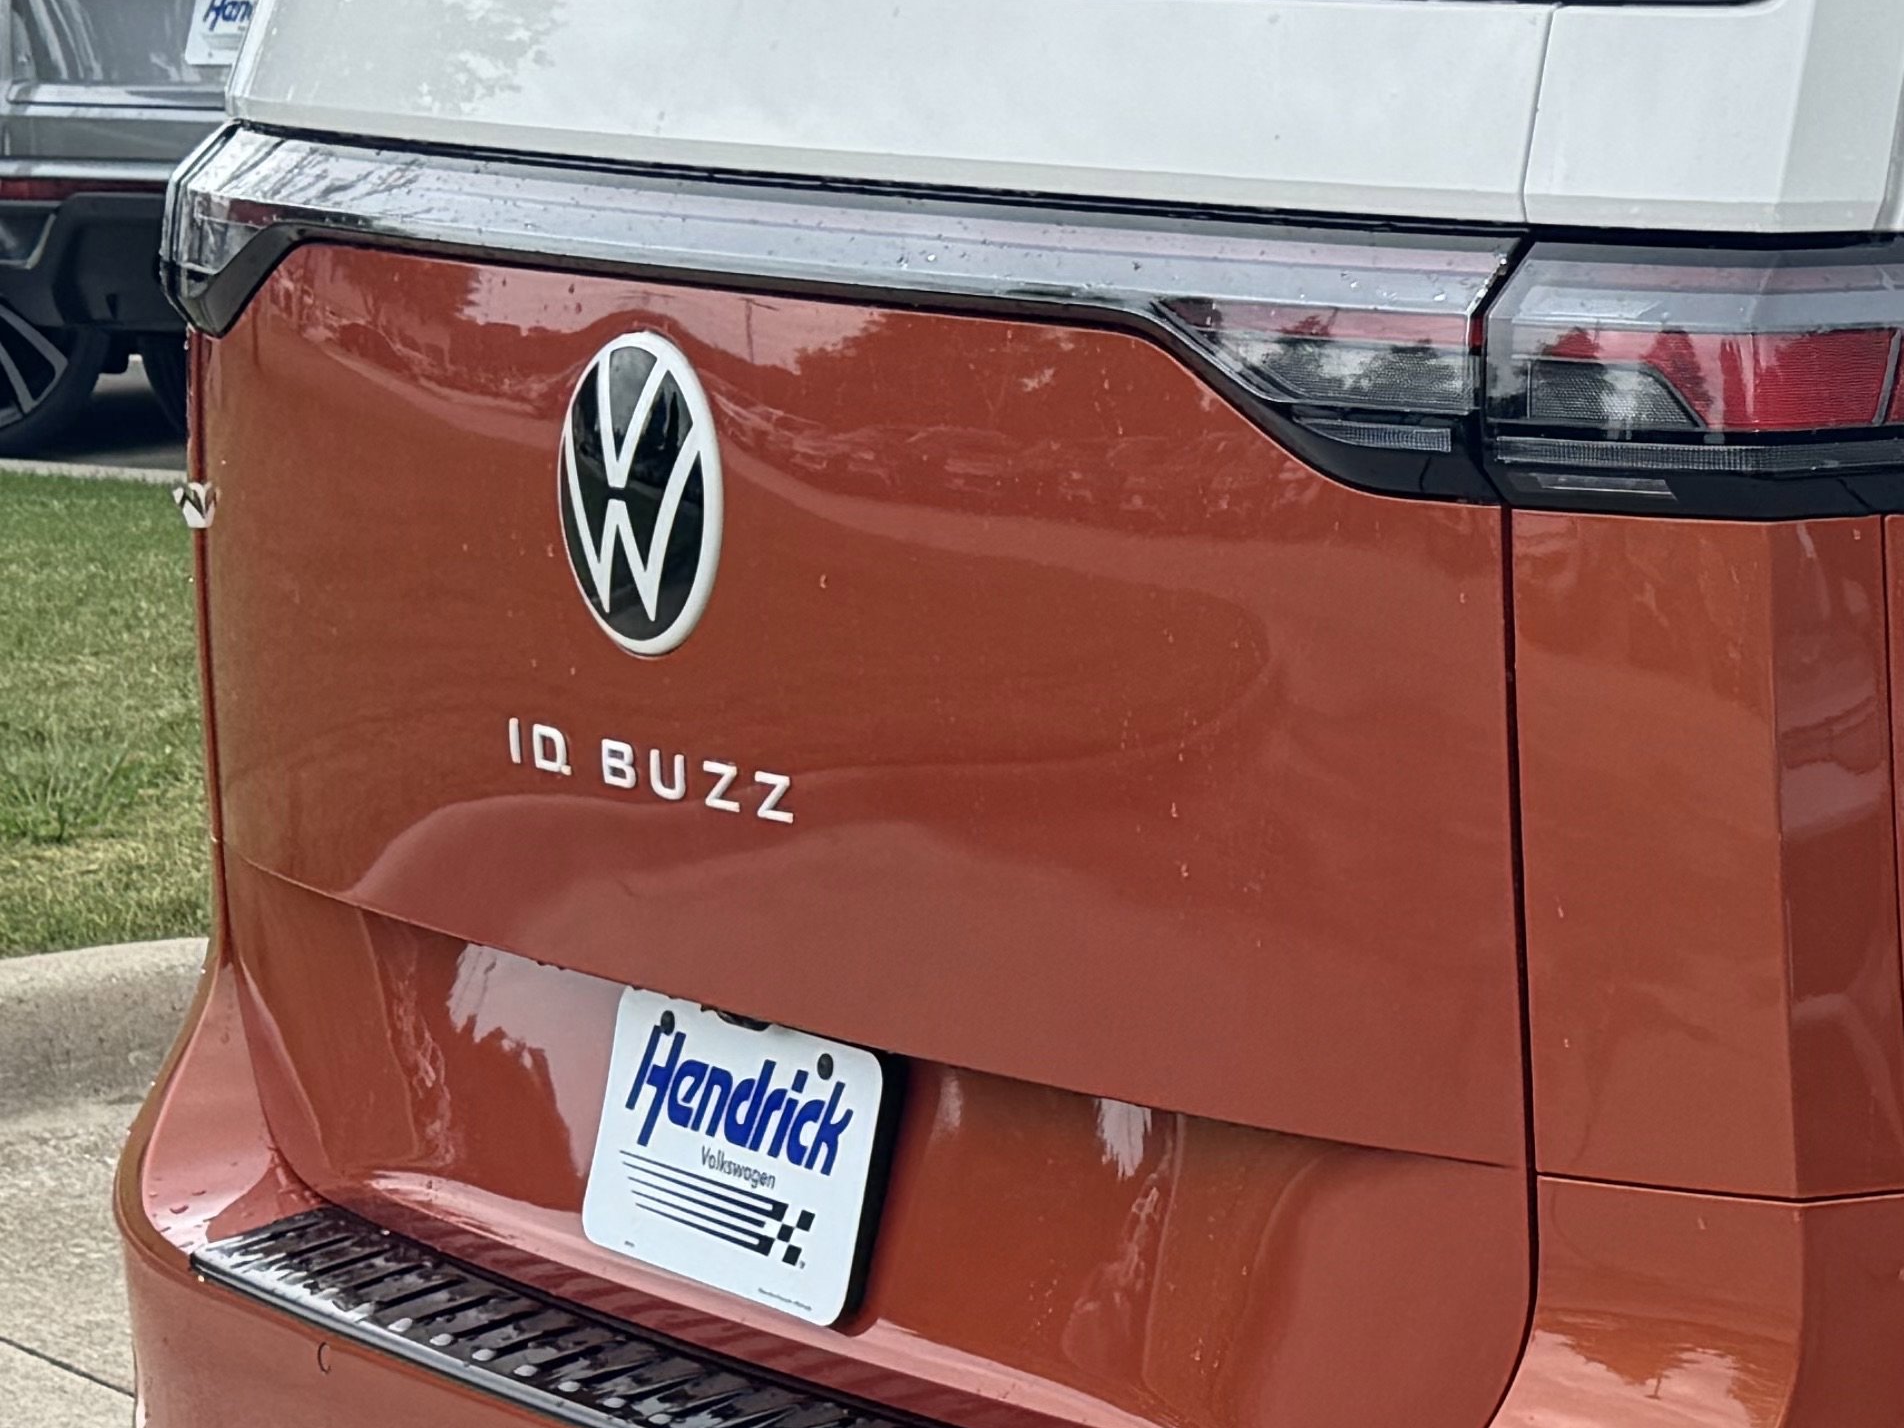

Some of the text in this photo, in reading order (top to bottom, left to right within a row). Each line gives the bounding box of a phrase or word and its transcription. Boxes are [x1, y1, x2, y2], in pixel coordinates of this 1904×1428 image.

[601, 737, 794, 824] BUZZ
[625, 1024, 854, 1176] Hendrick
[701, 1145, 776, 1190] Volkswagen
